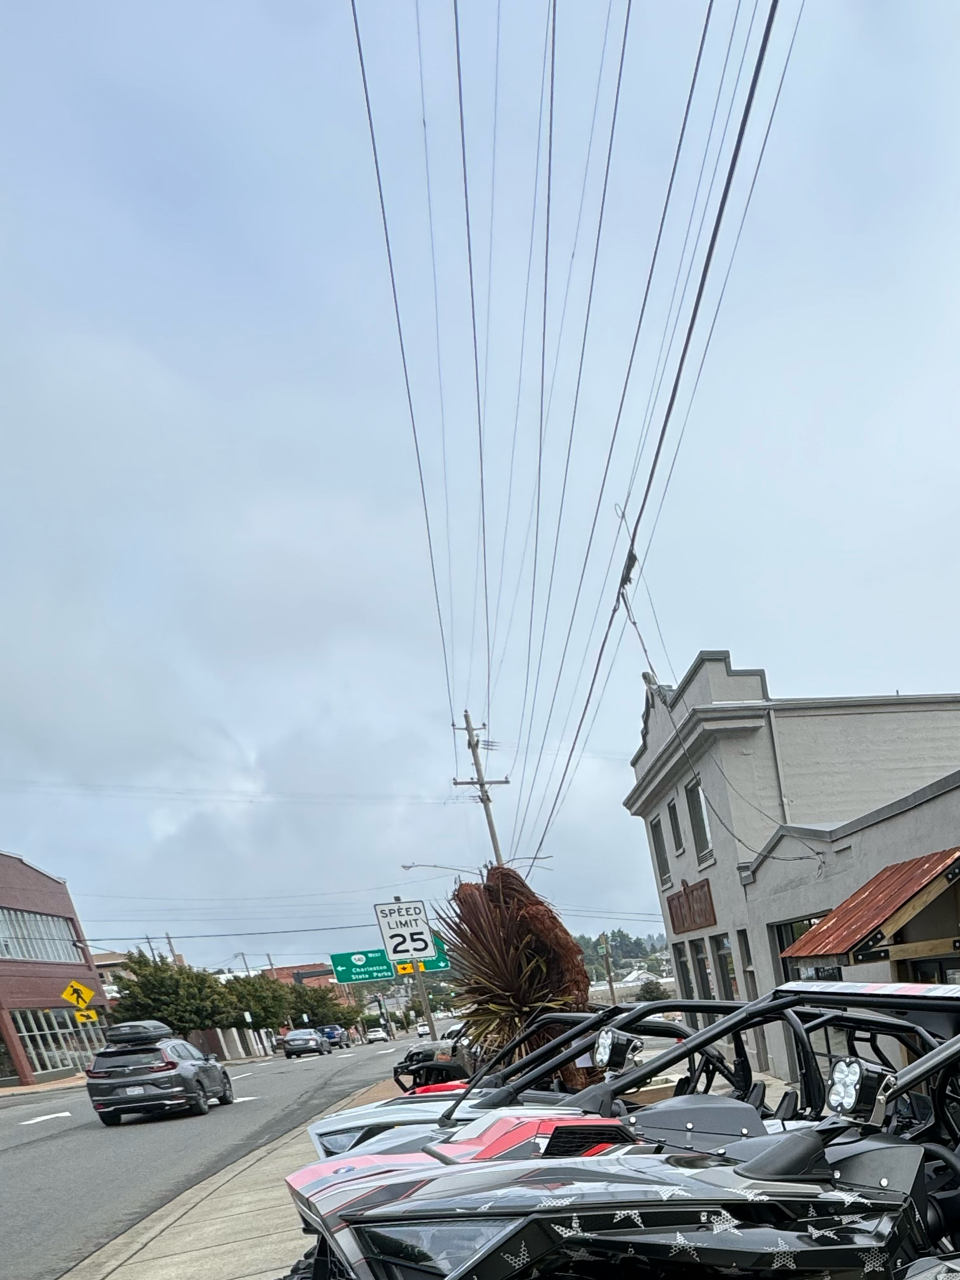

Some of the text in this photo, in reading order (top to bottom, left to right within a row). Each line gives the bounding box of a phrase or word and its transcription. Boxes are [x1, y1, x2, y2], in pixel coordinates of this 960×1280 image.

[380, 906, 422, 918] SPEED
[387, 918, 420, 930] LIMIT
[388, 931, 429, 954] 25
[351, 965, 387, 973] Charleston
